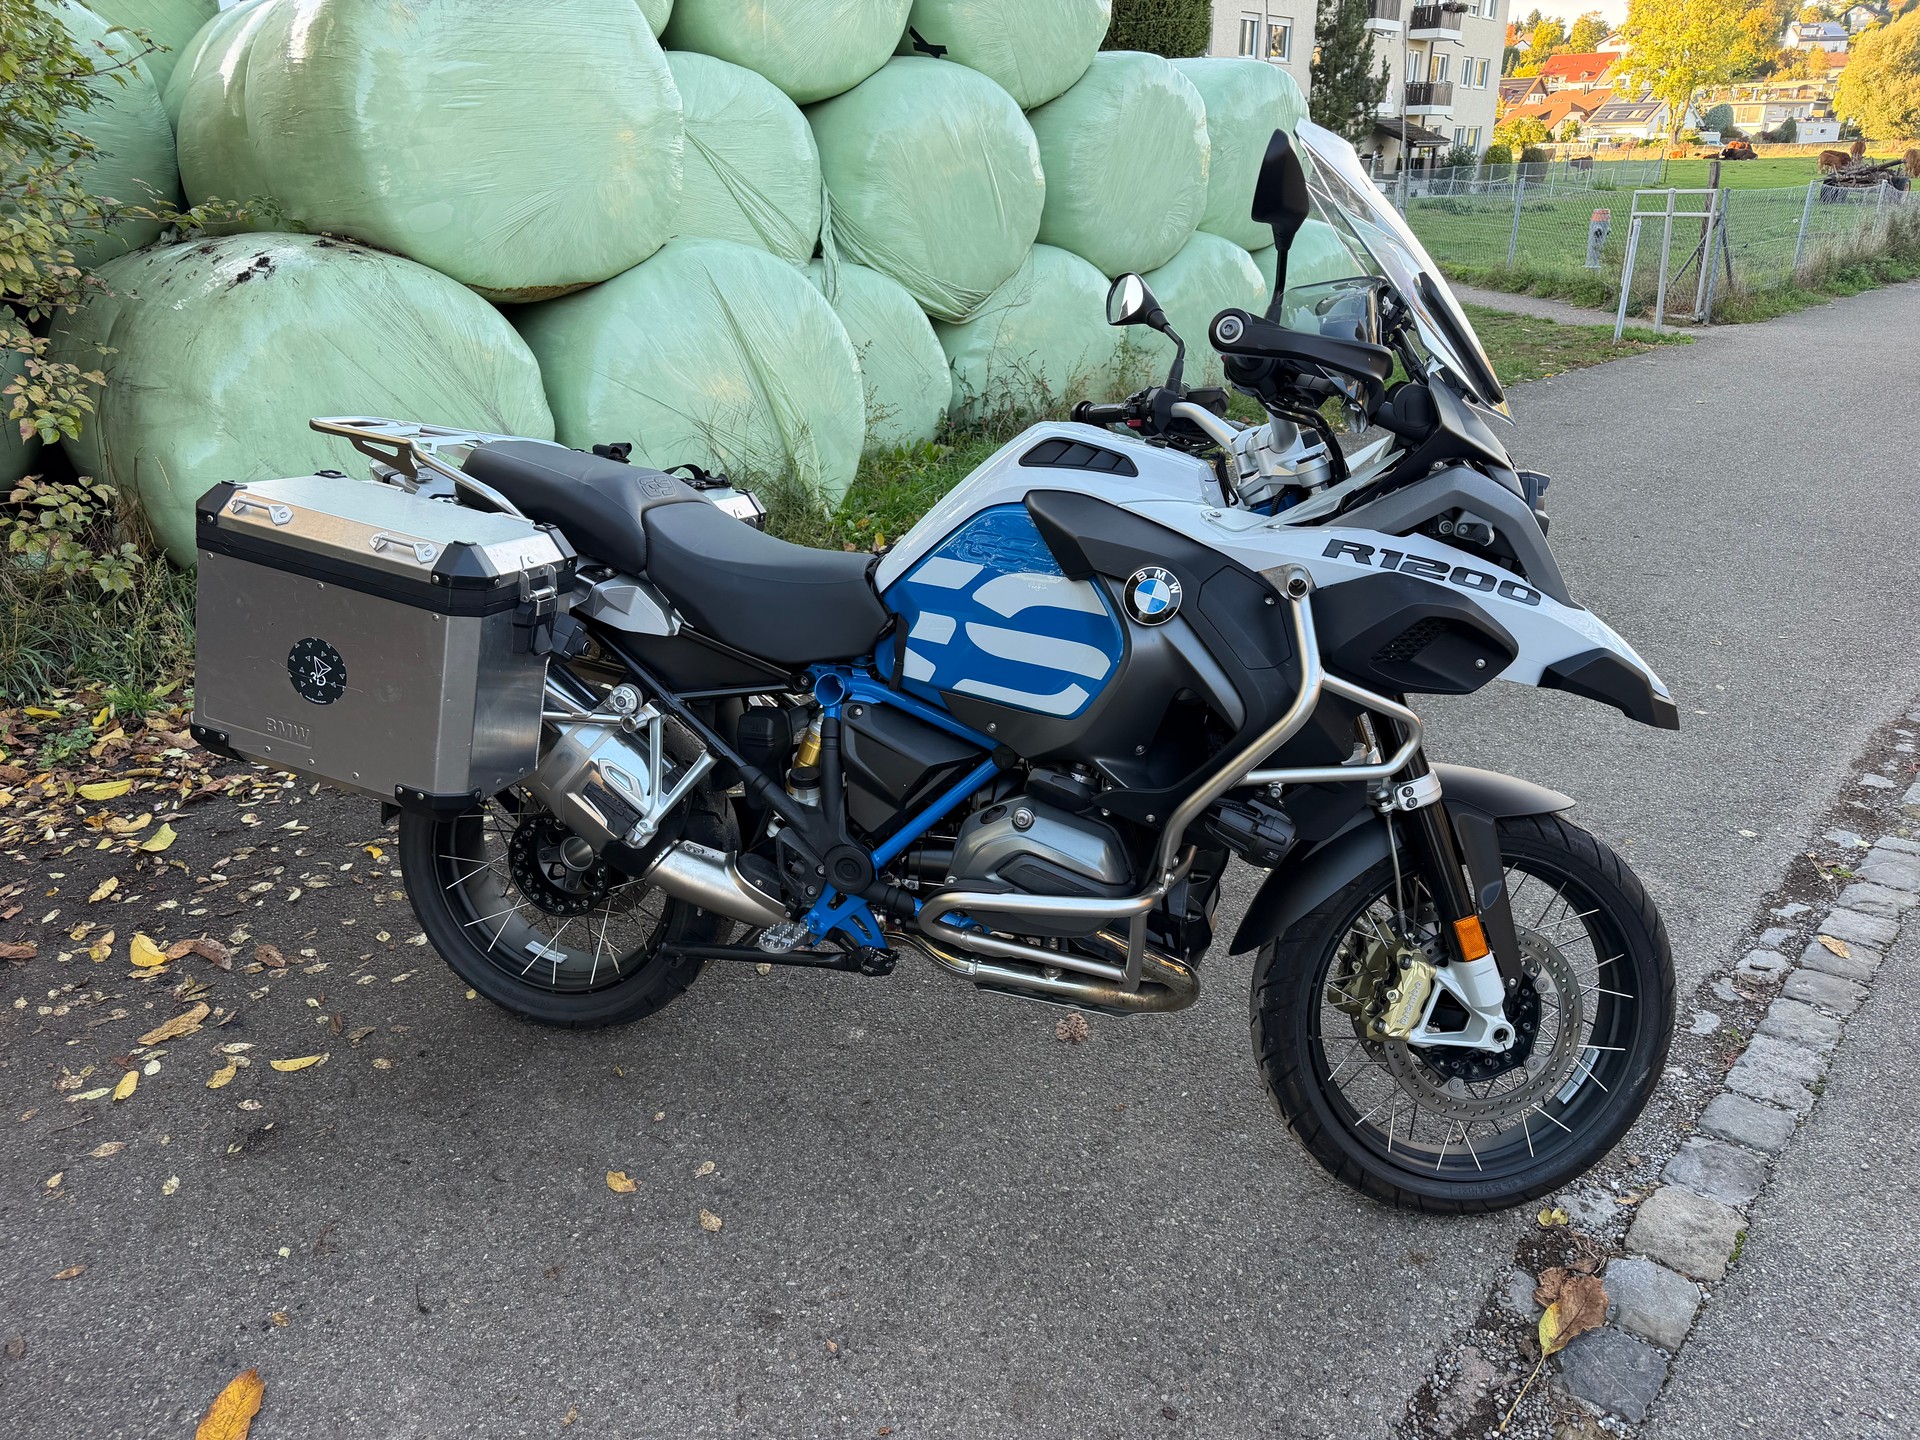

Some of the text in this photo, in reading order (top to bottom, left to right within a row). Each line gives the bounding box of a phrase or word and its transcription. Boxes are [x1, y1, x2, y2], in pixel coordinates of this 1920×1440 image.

[640, 475, 675, 497] GS
[1136, 569, 1180, 594] BMW
[1322, 538, 1542, 606] R1200
[266, 716, 310, 743] BMW
[1397, 981, 1423, 1026] brembo
